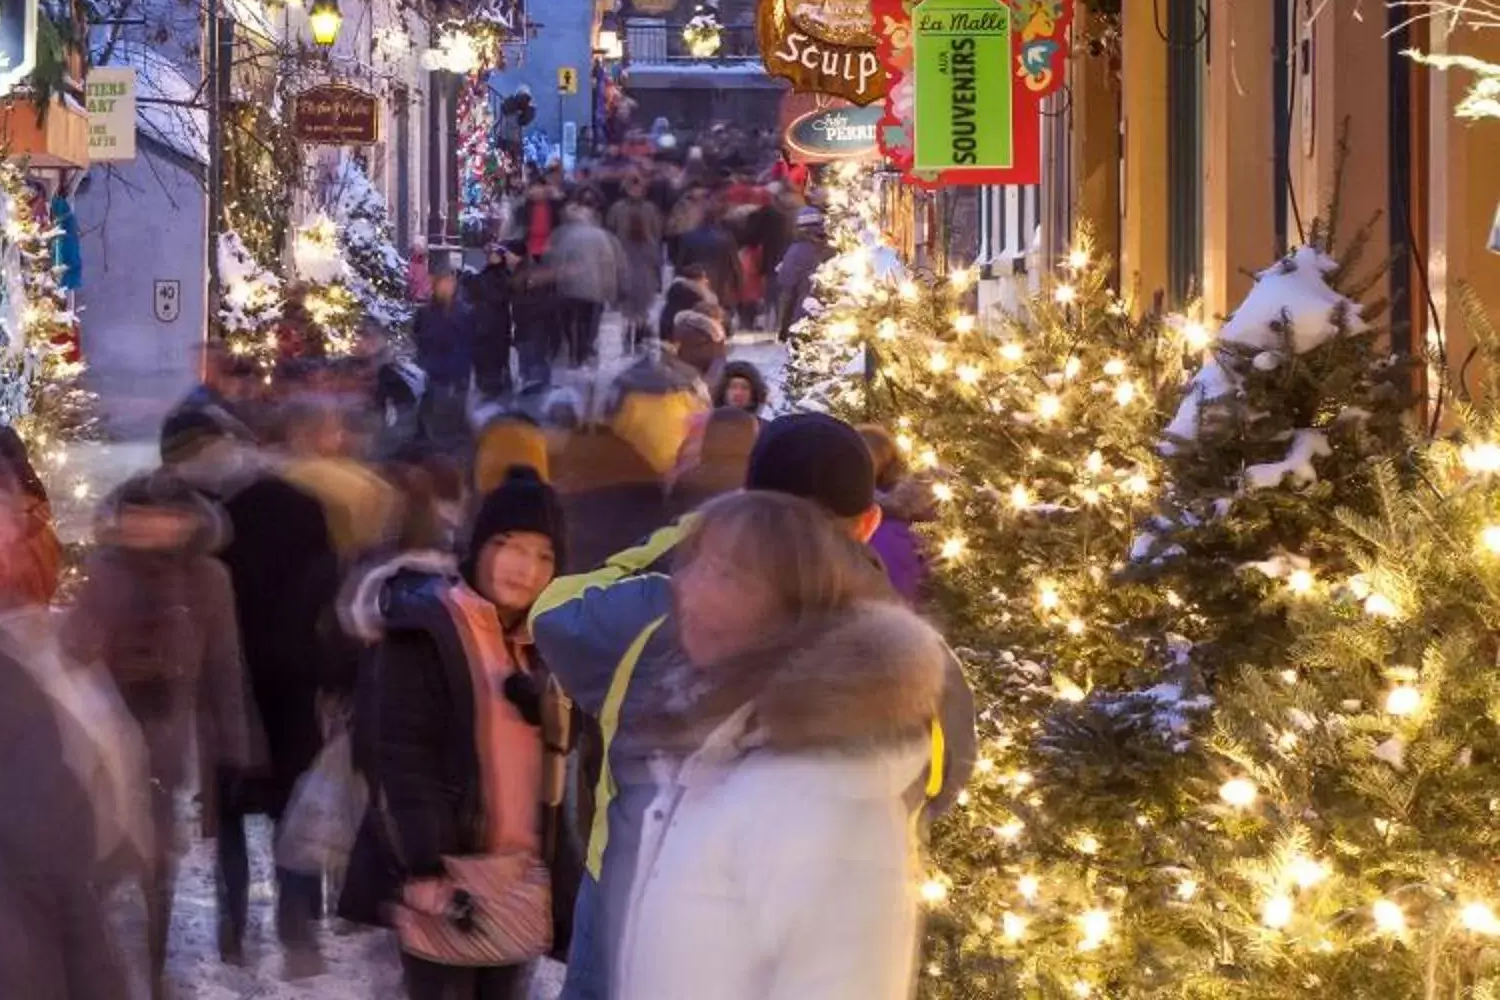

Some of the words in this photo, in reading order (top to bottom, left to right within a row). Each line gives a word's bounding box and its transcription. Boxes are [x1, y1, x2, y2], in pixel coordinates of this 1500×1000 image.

[919, 15, 943, 31] La
[950, 12, 1008, 31] Malle
[775, 33, 878, 94] Sculp
[938, 51, 950, 75] AUX
[952, 36, 977, 165] SOUVENIRS
